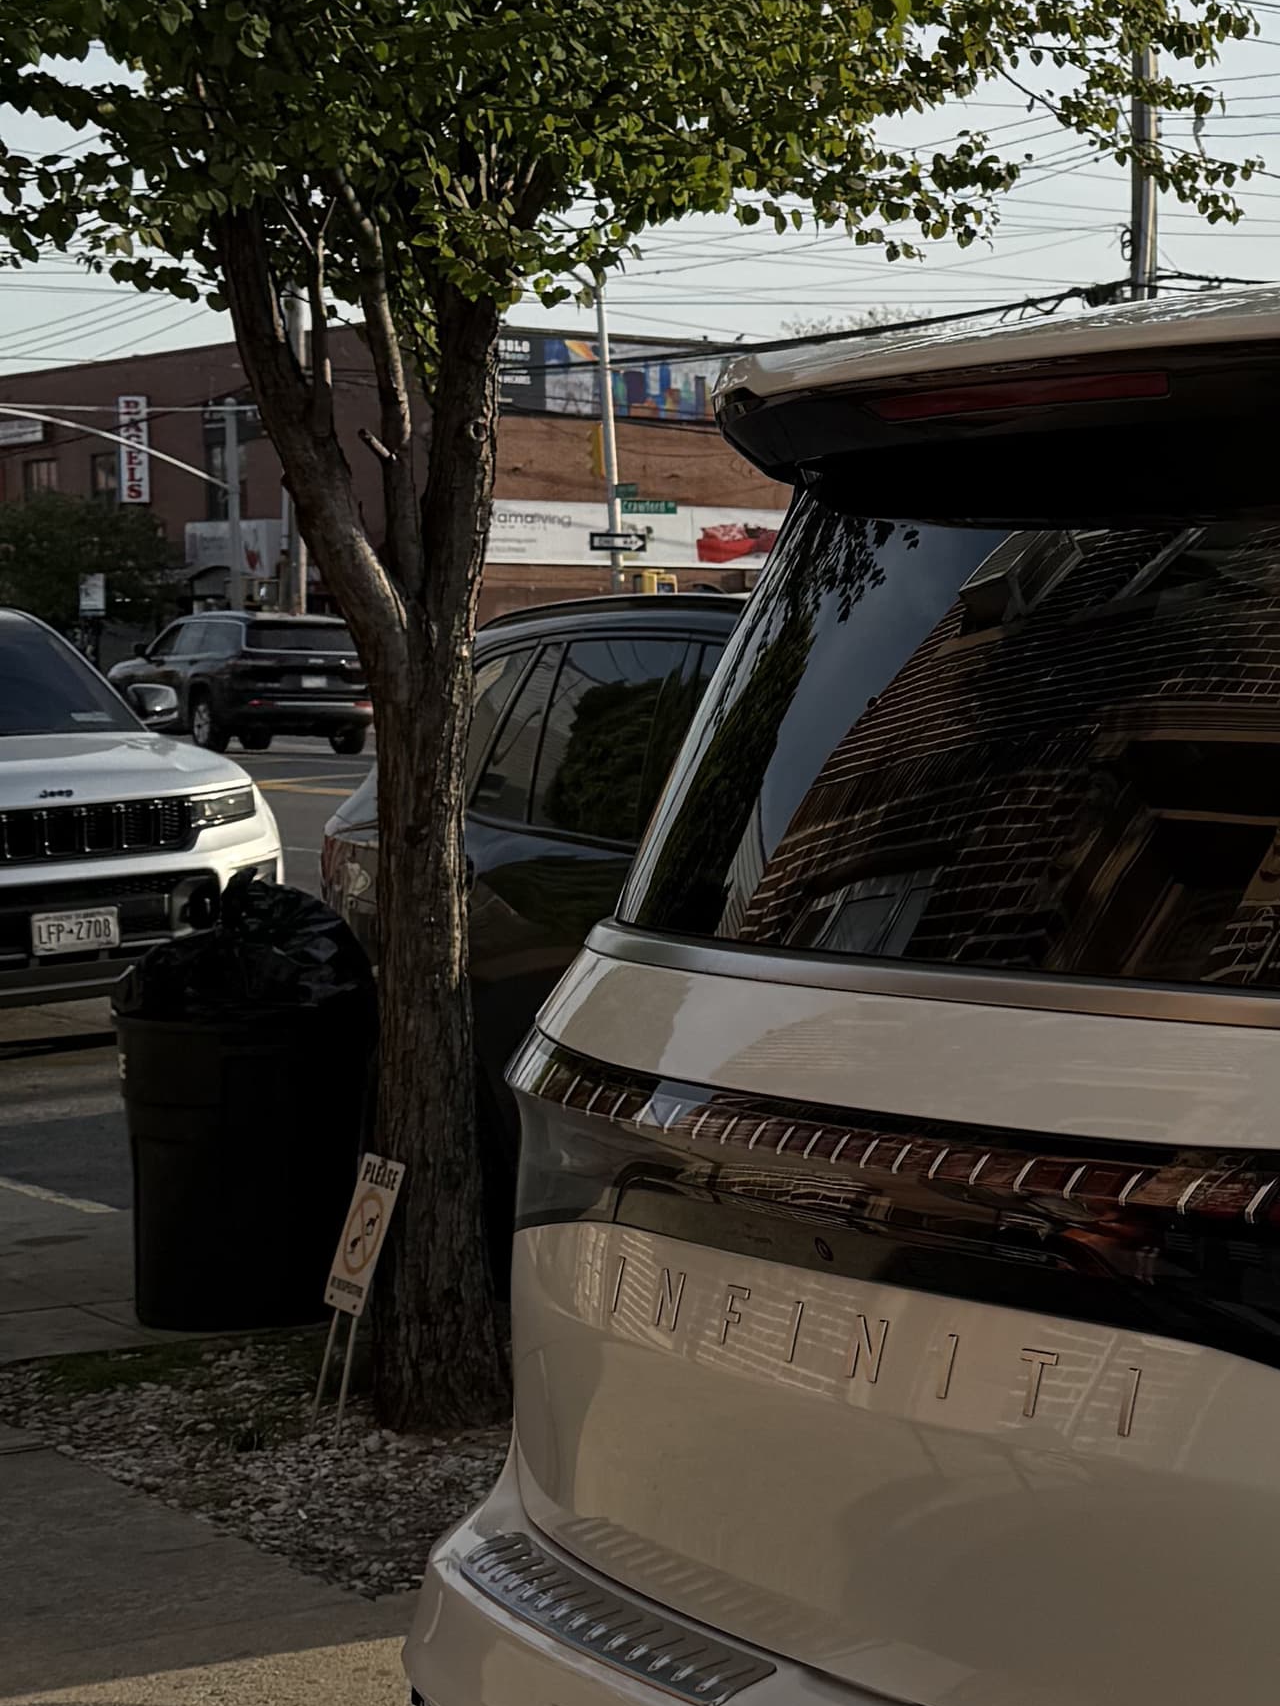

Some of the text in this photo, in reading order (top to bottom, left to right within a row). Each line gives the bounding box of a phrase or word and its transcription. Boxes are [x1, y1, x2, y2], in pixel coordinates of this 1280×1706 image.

[622, 501, 666, 513] Crawford
[361, 1160, 399, 1192] PLEASE
[609, 1254, 1143, 1439] INFINITI
